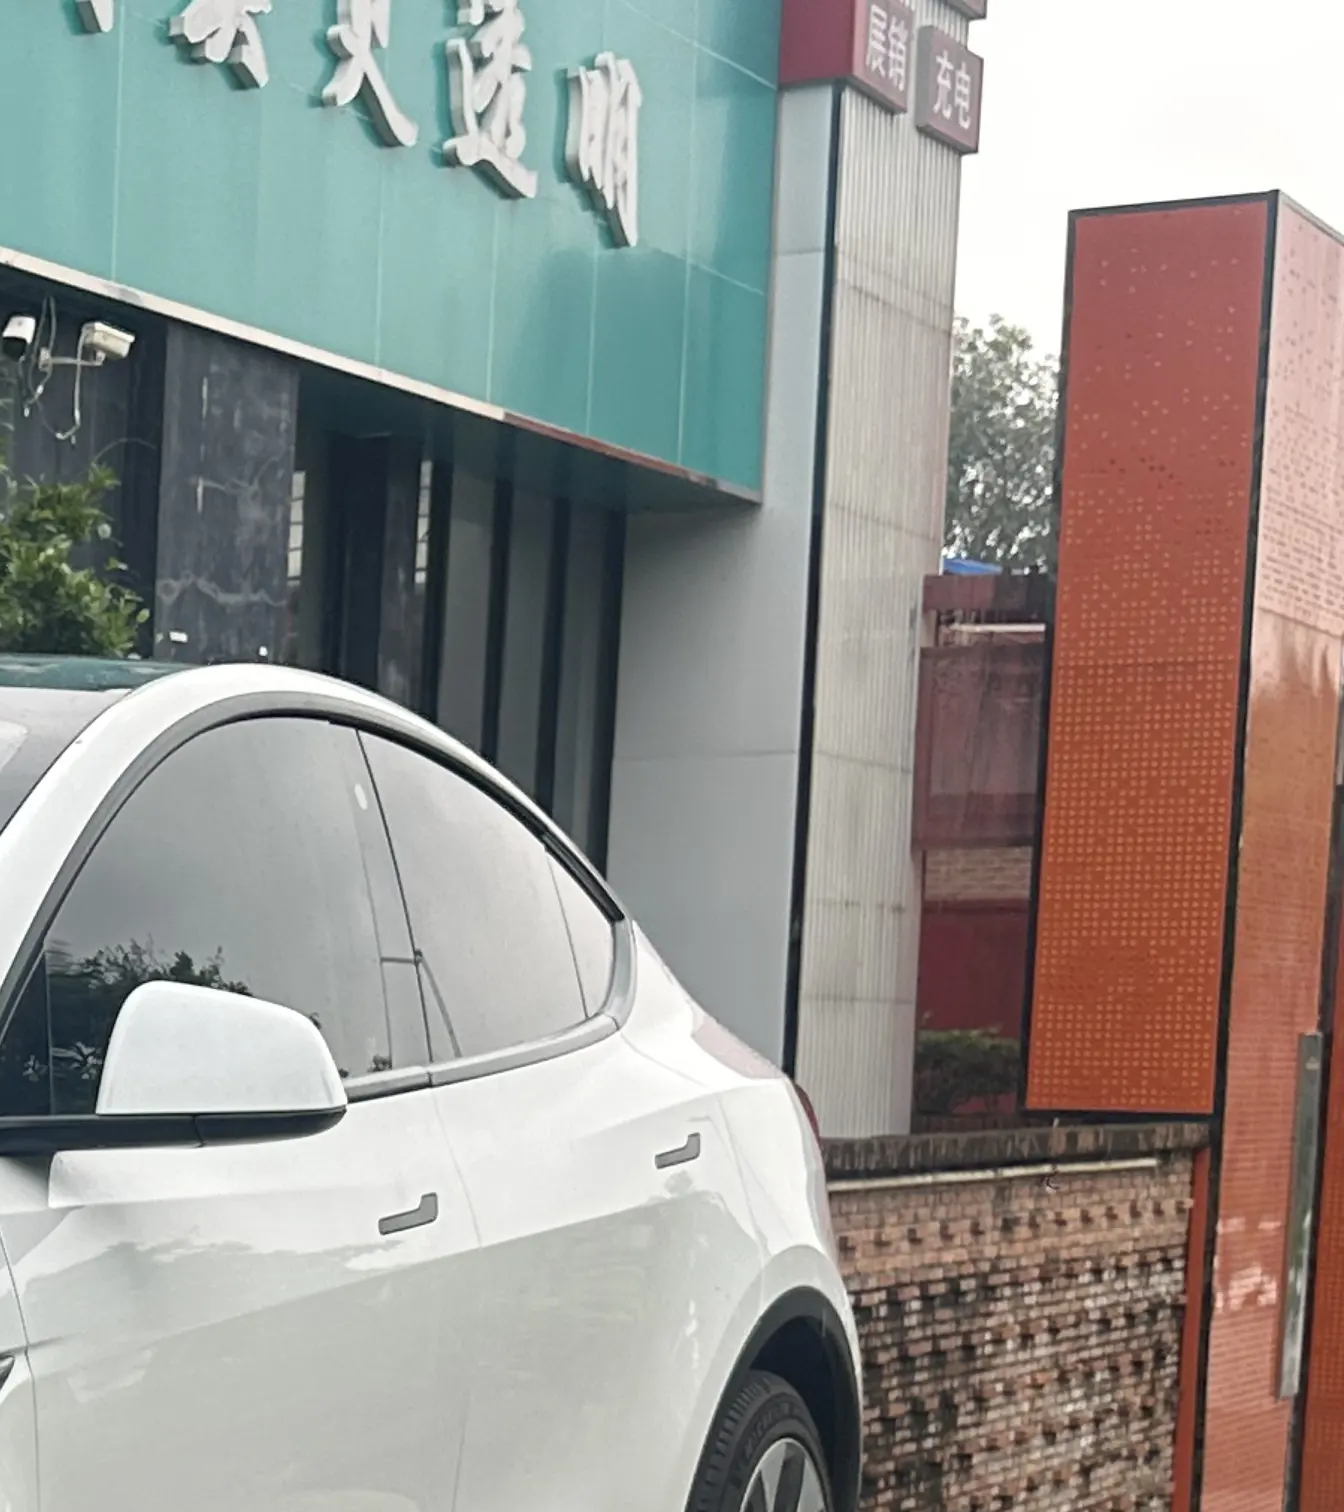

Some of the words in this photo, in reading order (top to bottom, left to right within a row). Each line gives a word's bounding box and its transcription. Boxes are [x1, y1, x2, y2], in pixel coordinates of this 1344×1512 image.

[72, 0, 643, 248] 更透明
[932, 50, 972, 130] 充电
